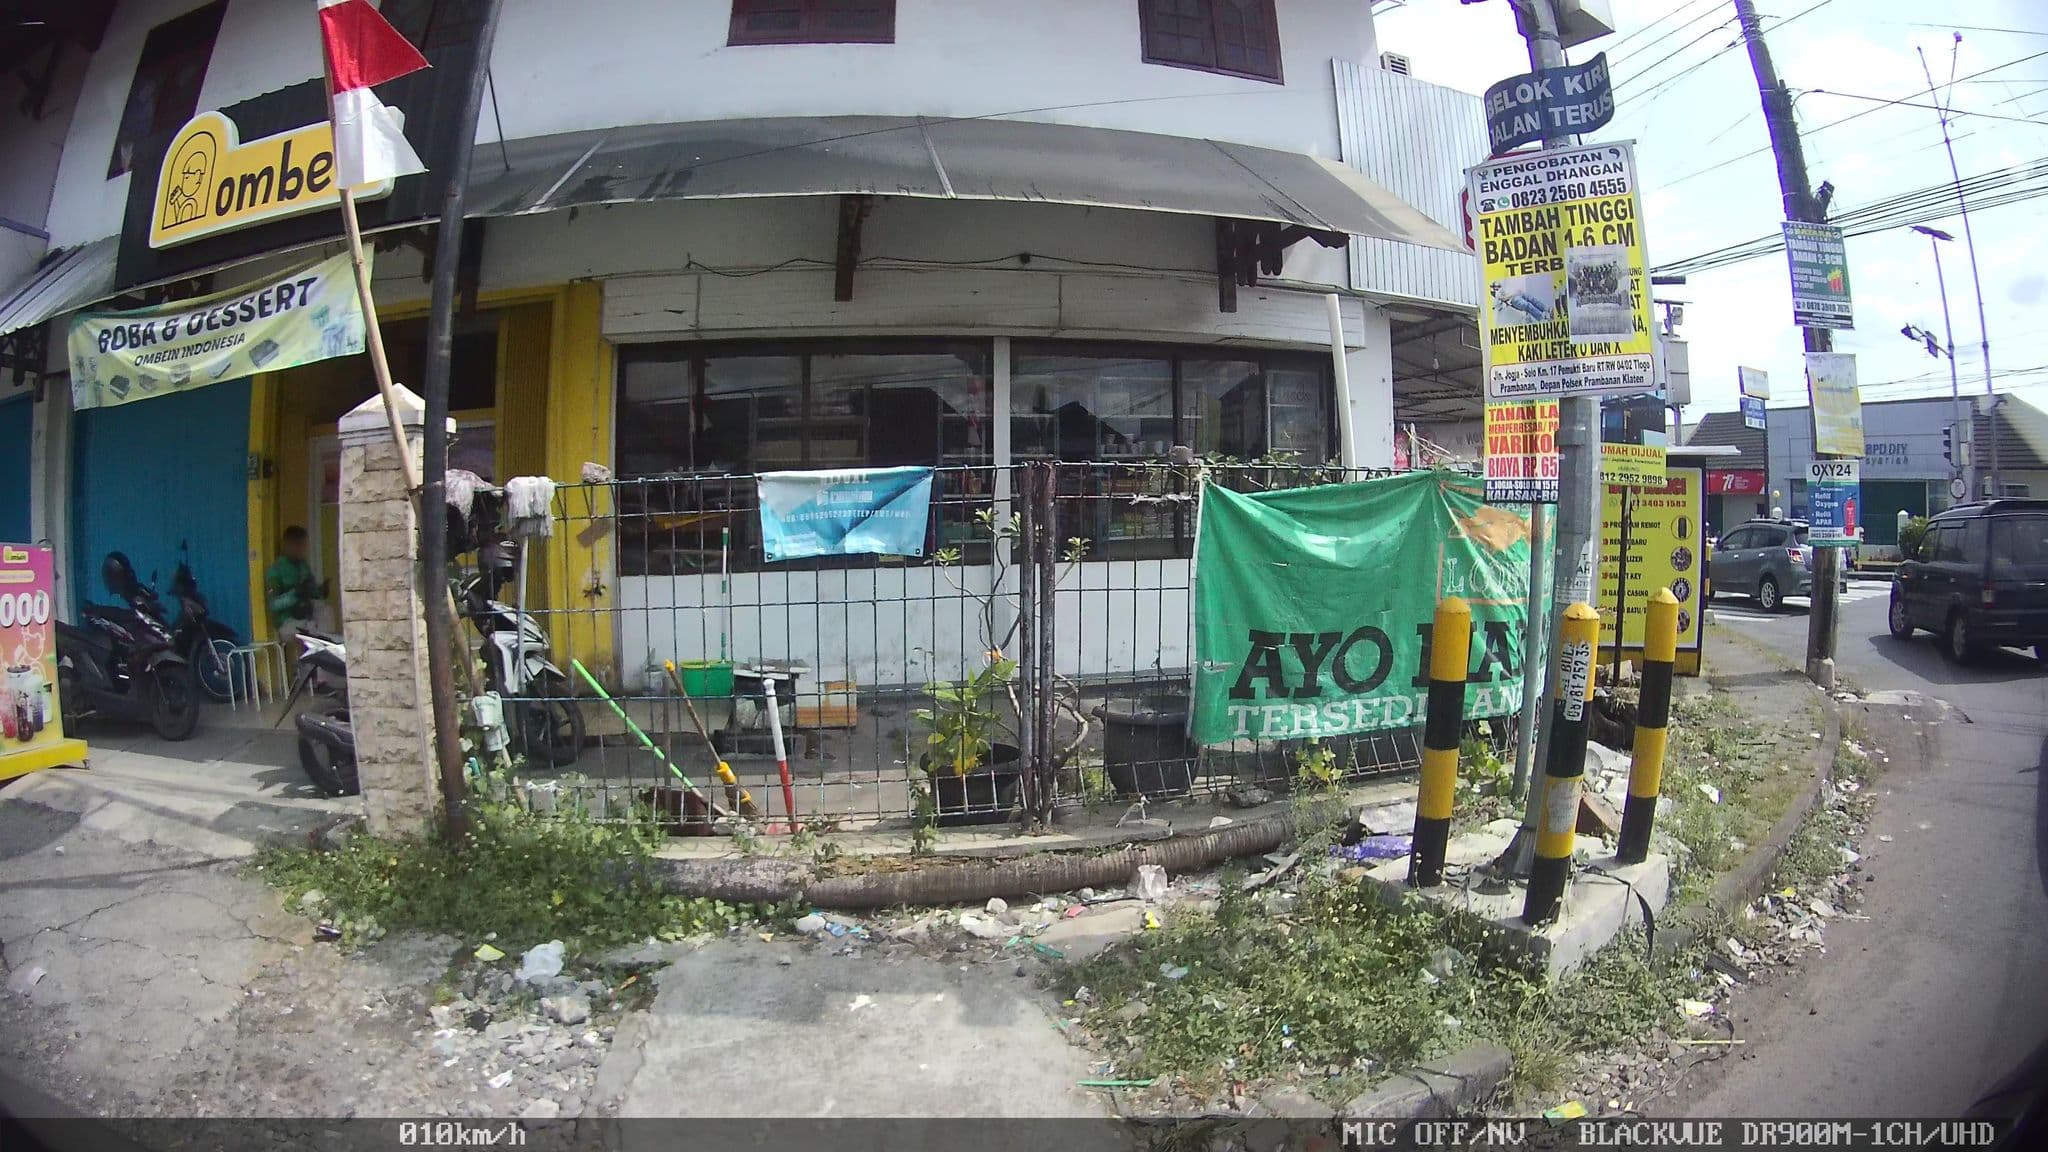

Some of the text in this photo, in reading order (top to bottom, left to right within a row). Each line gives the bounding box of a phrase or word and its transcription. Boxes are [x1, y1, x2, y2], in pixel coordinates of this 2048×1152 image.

[1486, 59, 1607, 120] BELOK KIRI
[1548, 88, 1612, 127] TERUS
[1480, 161, 1624, 193] ENGGAL DHANGAN
[1493, 152, 1603, 178] PENGOBATAN
[1511, 177, 1626, 208] 0823 2560 4555
[1480, 198, 1635, 239] TAMBAH TINGGI
[1485, 232, 1558, 264] BADAN
[1602, 223, 1635, 247] CM
[1505, 257, 1564, 277] TERB
[1629, 267, 1642, 276] UNG
[98, 277, 318, 354] BOBA & DESSERT
[134, 332, 246, 367] OMBEIN INDONESIA
[1517, 345, 1543, 362] KAKI
[1590, 341, 1611, 355] DAN
[1500, 374, 1644, 393] Prambanan, Depan Polsek Prambanan Klaten
[1505, 368, 1520, 381] Jogja
[1524, 367, 1536, 378] Solo
[1550, 365, 1557, 376] 17
[1582, 363, 1595, 373] Baru
[1488, 433, 1559, 455] VARIKO
[1600, 445, 1663, 458] UMAH DIJUAL
[1488, 456, 1558, 478] BIAYA RP. 65
[1600, 472, 1616, 481] 812
[1618, 473, 1640, 483] 2952
[1812, 464, 1851, 485] OXY24
[1609, 521, 1639, 529] PROAM
[1228, 625, 1394, 700] AYO
[1228, 692, 1429, 738] TERSEDI
